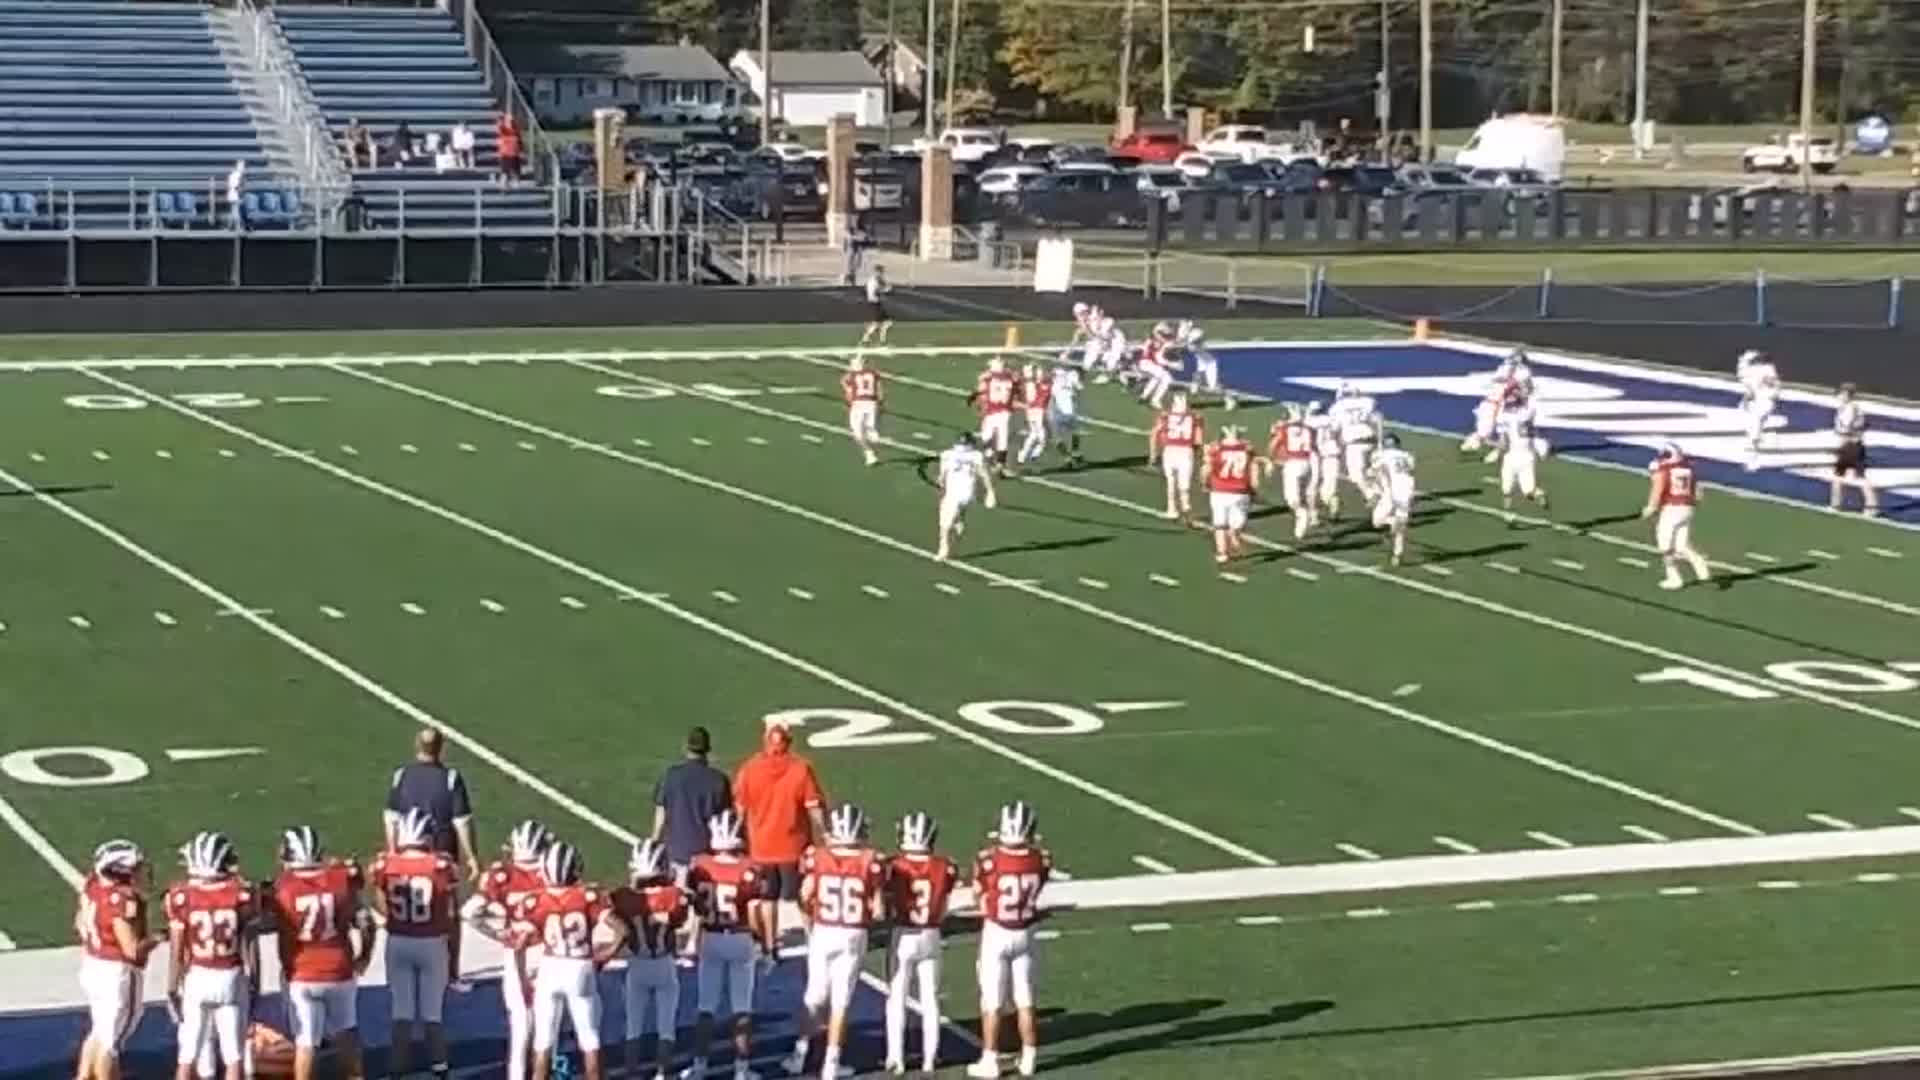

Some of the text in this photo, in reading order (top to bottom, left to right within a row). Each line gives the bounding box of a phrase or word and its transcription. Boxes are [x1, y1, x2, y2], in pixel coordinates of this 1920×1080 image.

[764, 701, 1105, 748] 20
[295, 895, 337, 942] 71
[389, 876, 434, 922] 58
[817, 875, 864, 925] 56
[908, 877, 931, 922] 3
[998, 873, 1040, 928] 27
[190, 908, 239, 958] 33
[544, 911, 590, 957] 42
